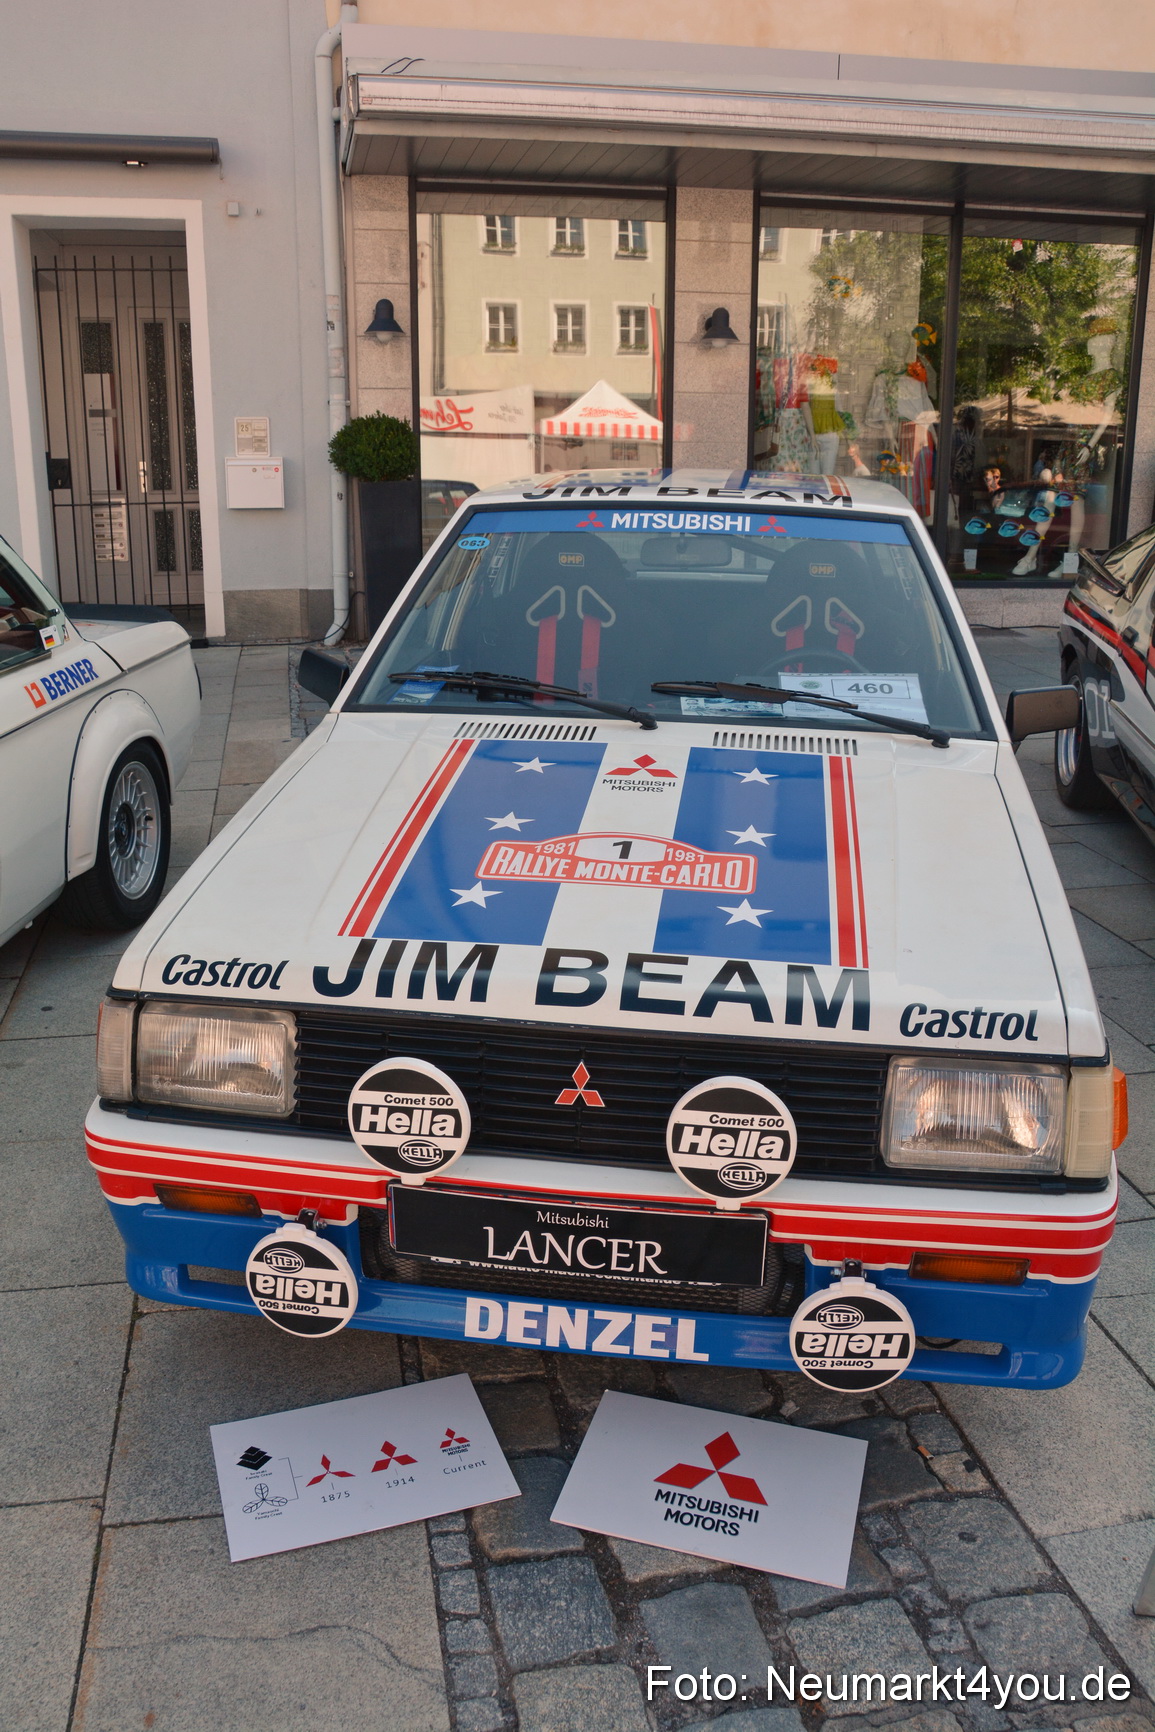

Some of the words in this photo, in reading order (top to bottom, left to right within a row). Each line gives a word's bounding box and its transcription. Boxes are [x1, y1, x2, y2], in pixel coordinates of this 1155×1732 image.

[240, 424, 250, 432] 25
[522, 486, 633, 500] JIM
[656, 486, 853, 508] BEAM
[611, 513, 750, 532] MITSUBISHI
[40, 659, 99, 701] BERNER
[847, 682, 893, 695] 460
[602, 779, 676, 787] MITSUBISHI
[611, 785, 664, 793] MOTORS
[534, 842, 576, 855] 1981
[612, 840, 633, 859] 1
[666, 848, 704, 863] 1981
[490, 846, 567, 878] RALLYE
[574, 860, 743, 889] MONTE-CARLO
[161, 954, 290, 990] Castrol
[312, 938, 500, 1002] JIM
[535, 947, 870, 1032] BEAM
[900, 1002, 1038, 1041] Castrol
[384, 1094, 425, 1106] Comet
[429, 1097, 453, 1106] 500
[359, 1105, 456, 1137] Hella
[709, 1114, 755, 1127] Comet
[758, 1117, 784, 1127] 500
[678, 1125, 784, 1159] Hella
[402, 1147, 441, 1159] HELLA
[722, 1170, 766, 1182] HELLA
[536, 1210, 609, 1229] Mitsubishi
[483, 1226, 667, 1275] LANCER
[265, 1254, 301, 1267] HELLA
[255, 1274, 342, 1305] Hella
[259, 1300, 279, 1309] 500
[282, 1303, 320, 1315] Comet
[818, 1312, 860, 1321] HELLA
[464, 1297, 709, 1361] DENZEL
[801, 1333, 903, 1357] Hella
[802, 1359, 827, 1367] 500
[830, 1360, 874, 1368] Comet
[443, 1460, 487, 1475] Current
[386, 1476, 415, 1489] 1914
[321, 1490, 350, 1503] 1875
[654, 1489, 759, 1523] MITSUBISHI
[664, 1508, 740, 1536] MOTORS
